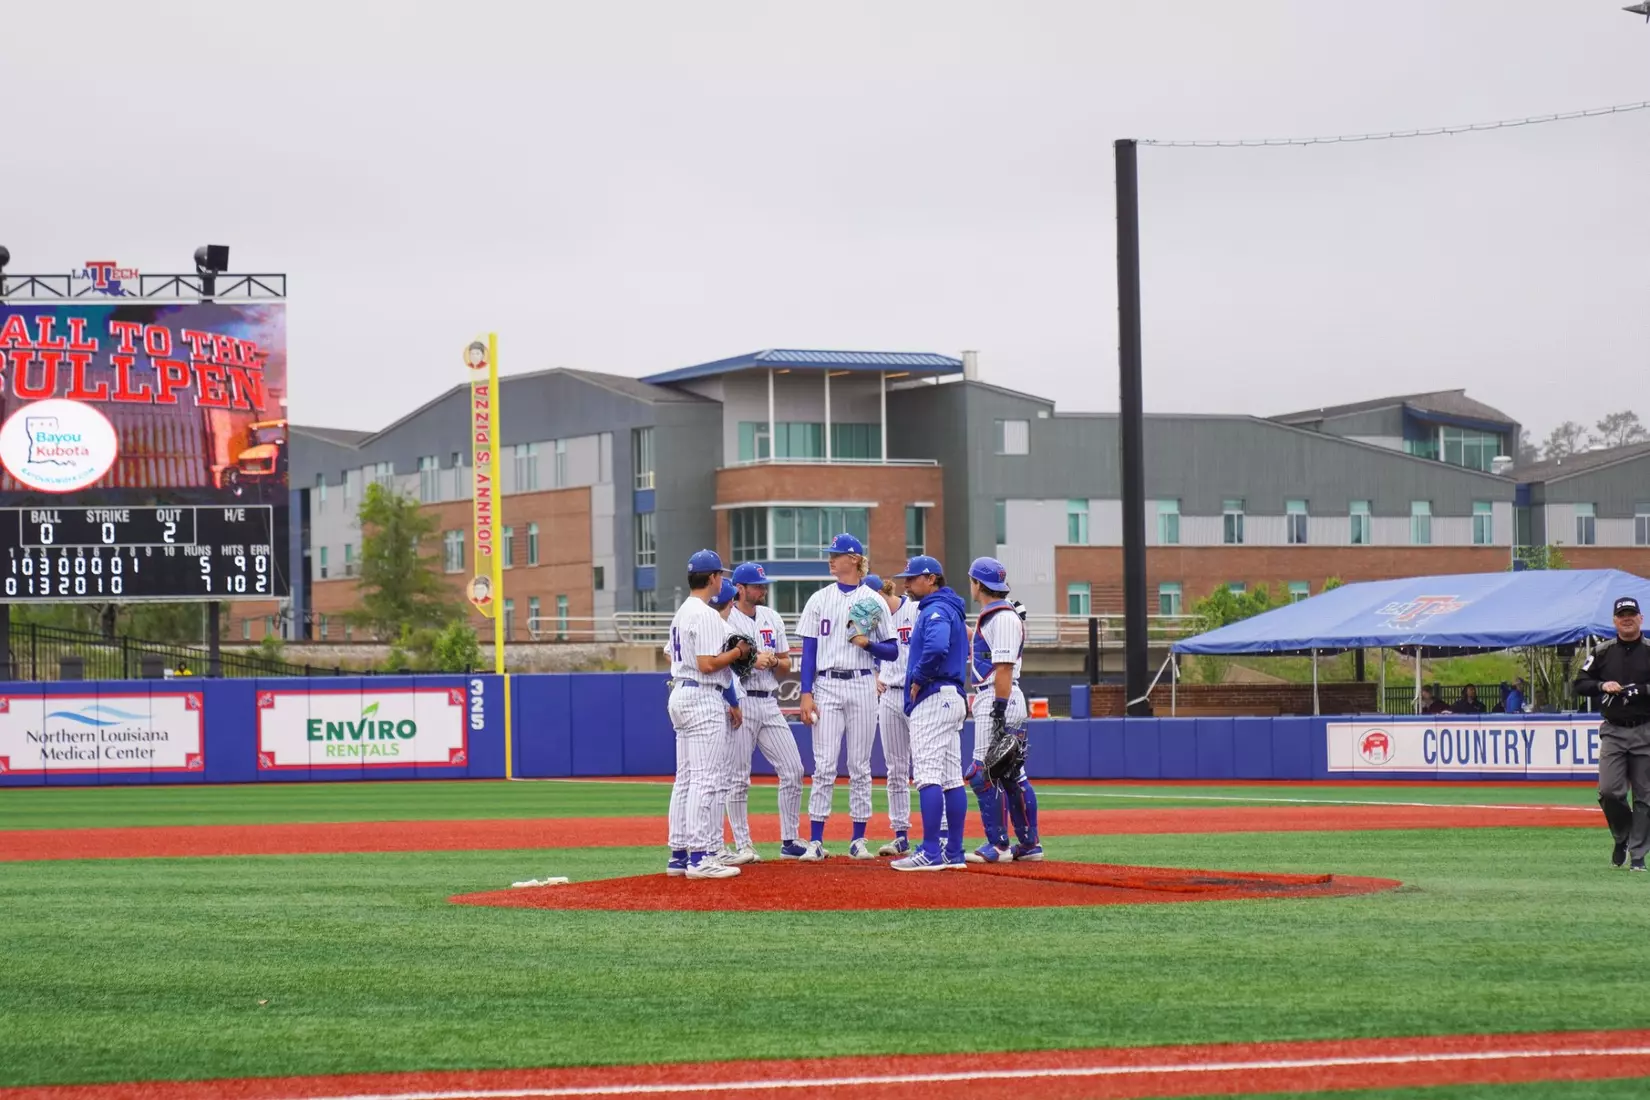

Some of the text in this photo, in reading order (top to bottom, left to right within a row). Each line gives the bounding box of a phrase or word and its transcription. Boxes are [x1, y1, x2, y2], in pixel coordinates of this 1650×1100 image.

[71, 268, 91, 280] LA
[109, 320, 172, 357] TO
[181, 328, 263, 370] THE
[0, 349, 266, 412] ULLPEN
[36, 432, 82, 444] Bayou
[36, 446, 90, 457] Kubota
[475, 385, 492, 555] JOHNNY'S PIZZA
[31, 508, 245, 523] BALL STRIKE OUT H/E
[40, 522, 176, 544] 0 0 2
[9, 544, 270, 558] 1 2 3 4 5 6 7 8 9 10 RUNS HITS ERR
[11, 555, 266, 575] 1 0 3 0 0 0 0 1 5 9 0
[5, 574, 267, 595] 0 1 3 2 0 1 0 7 10 2
[470, 679, 485, 730] 325
[26, 728, 169, 744] Northern Louisiana
[39, 746, 156, 761] Medical Center
[326, 743, 400, 758] RENTALS
[1423, 729, 1535, 765] COUNTRY
